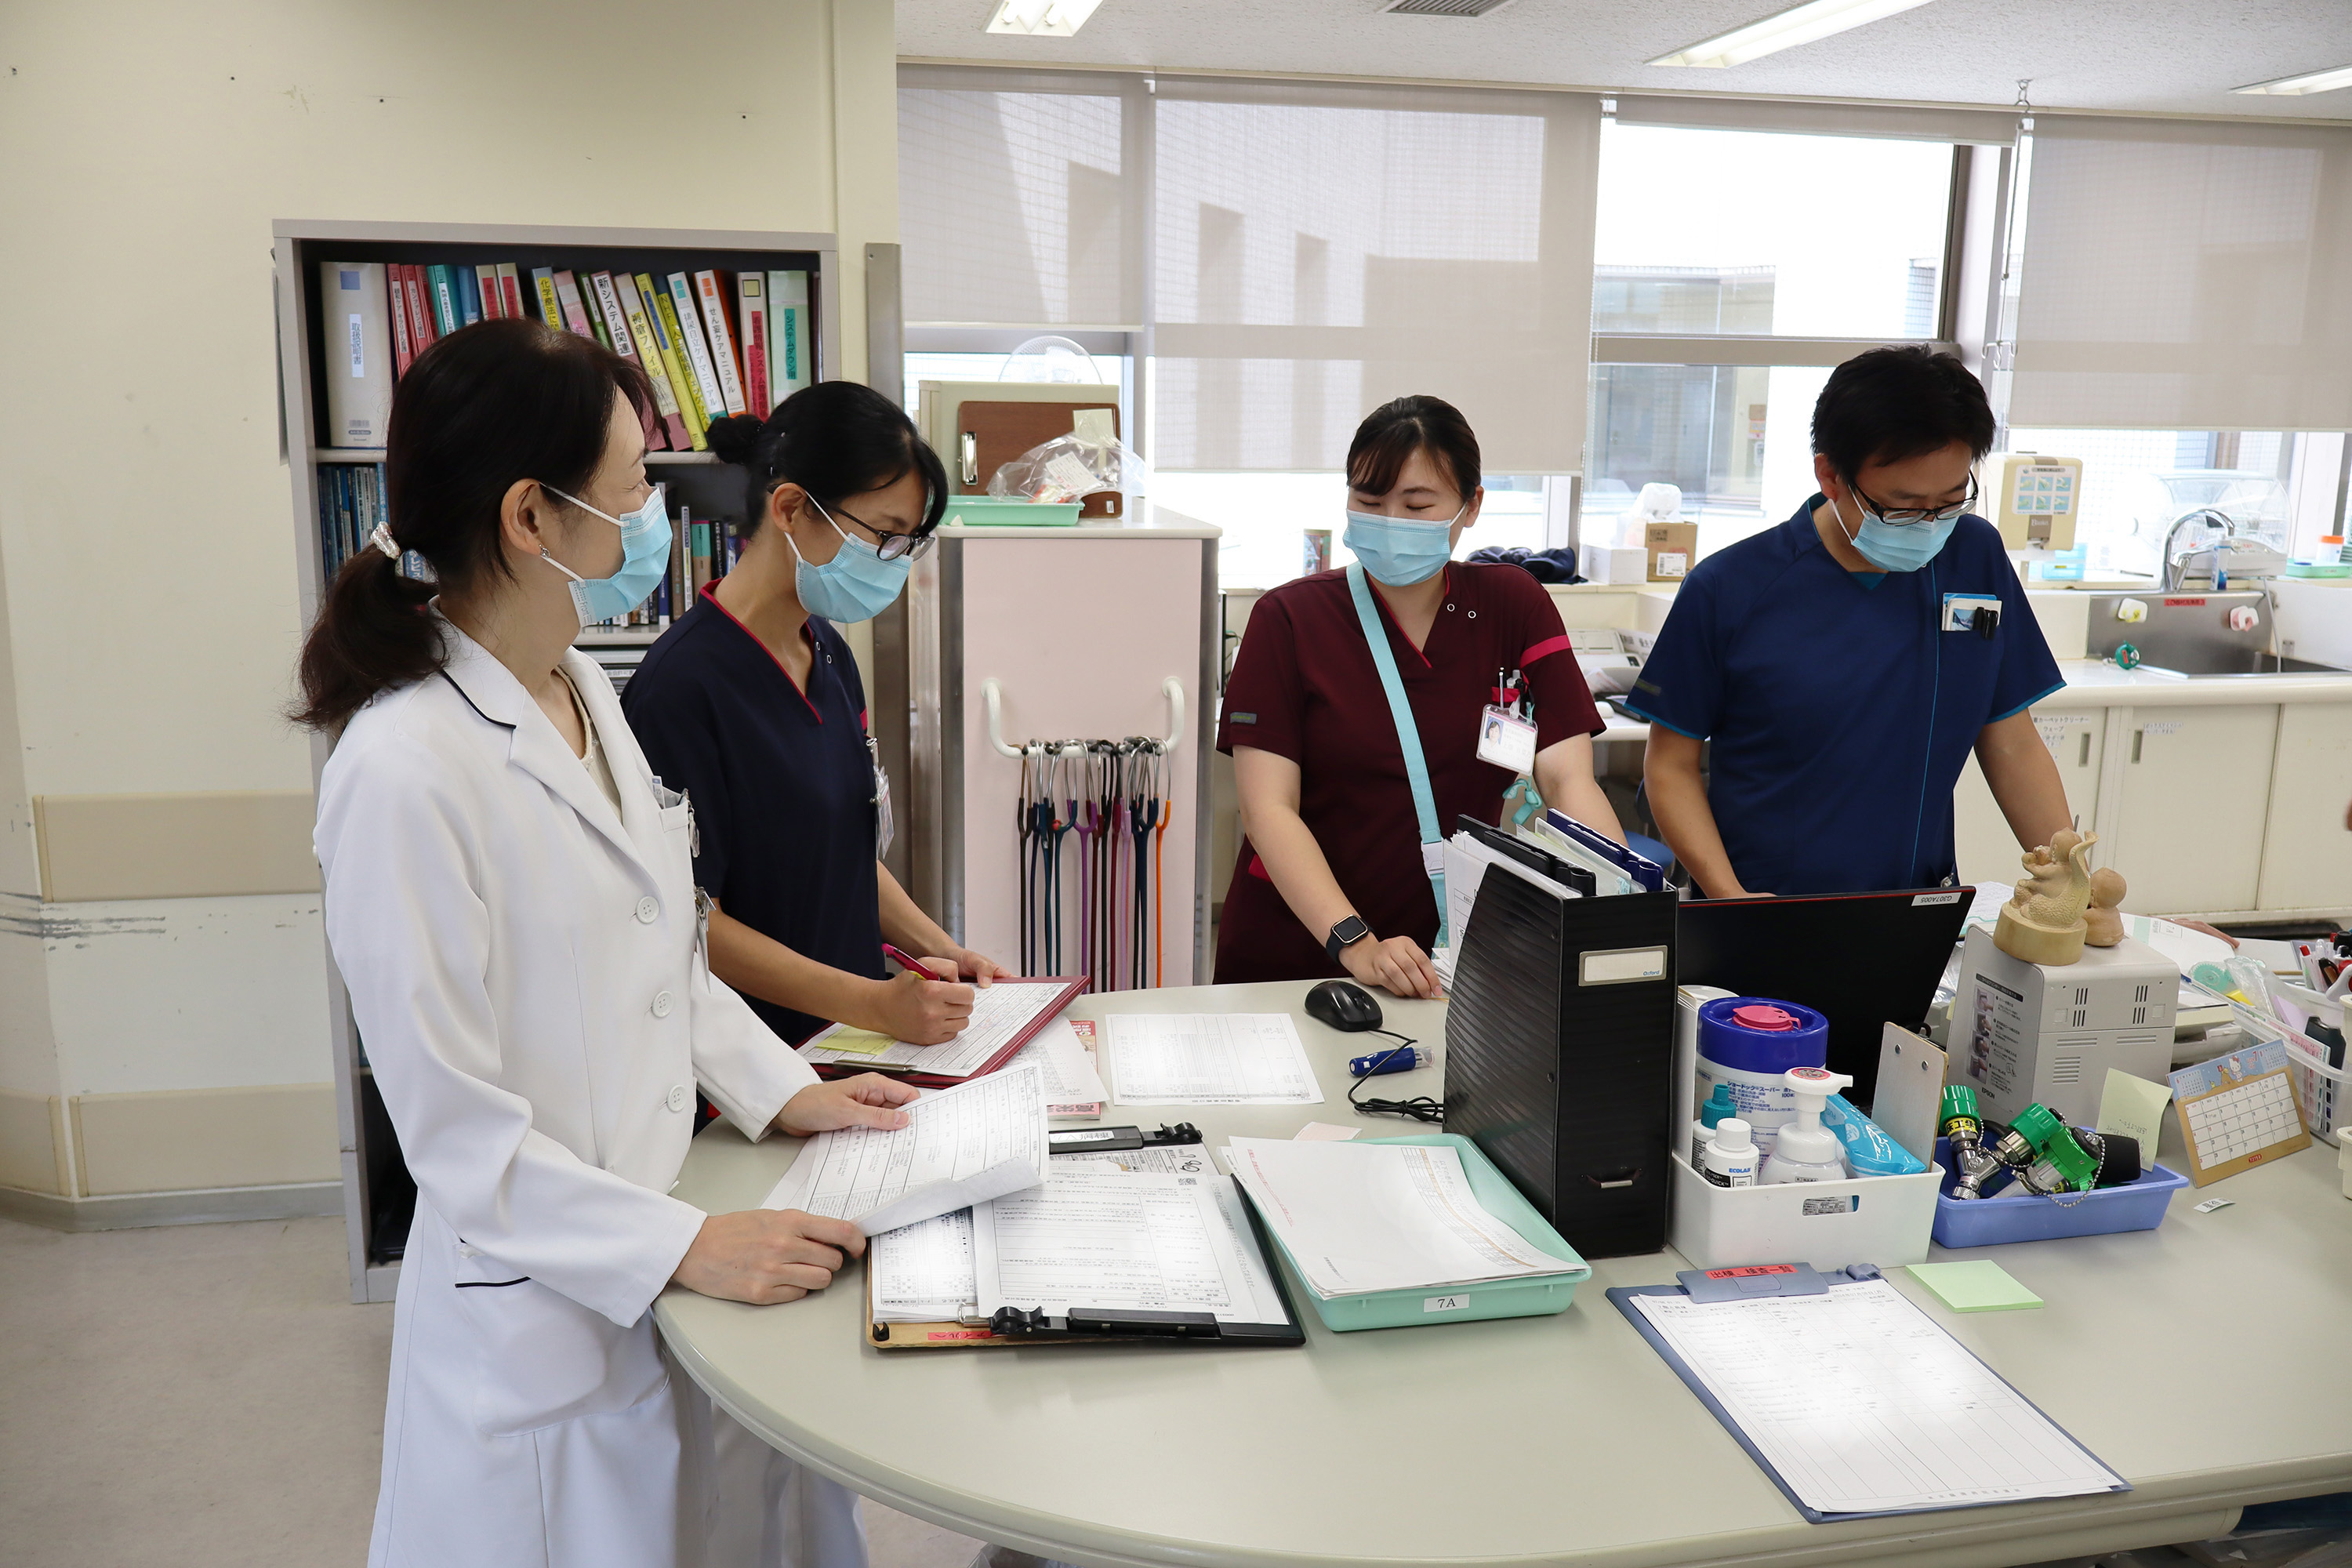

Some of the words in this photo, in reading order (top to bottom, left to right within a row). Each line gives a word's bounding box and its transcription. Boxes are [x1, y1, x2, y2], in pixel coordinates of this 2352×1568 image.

[597, 277, 631, 354] 新システム関連
[708, 307, 735, 394] せん妄ケアマニュアル
[786, 315, 797, 379] システムダウン用
[684, 312, 717, 406] 排尿自立ケアマニュアル
[1981, 1087, 1995, 1099] EPSON
[1437, 1298, 1457, 1309] 7A
